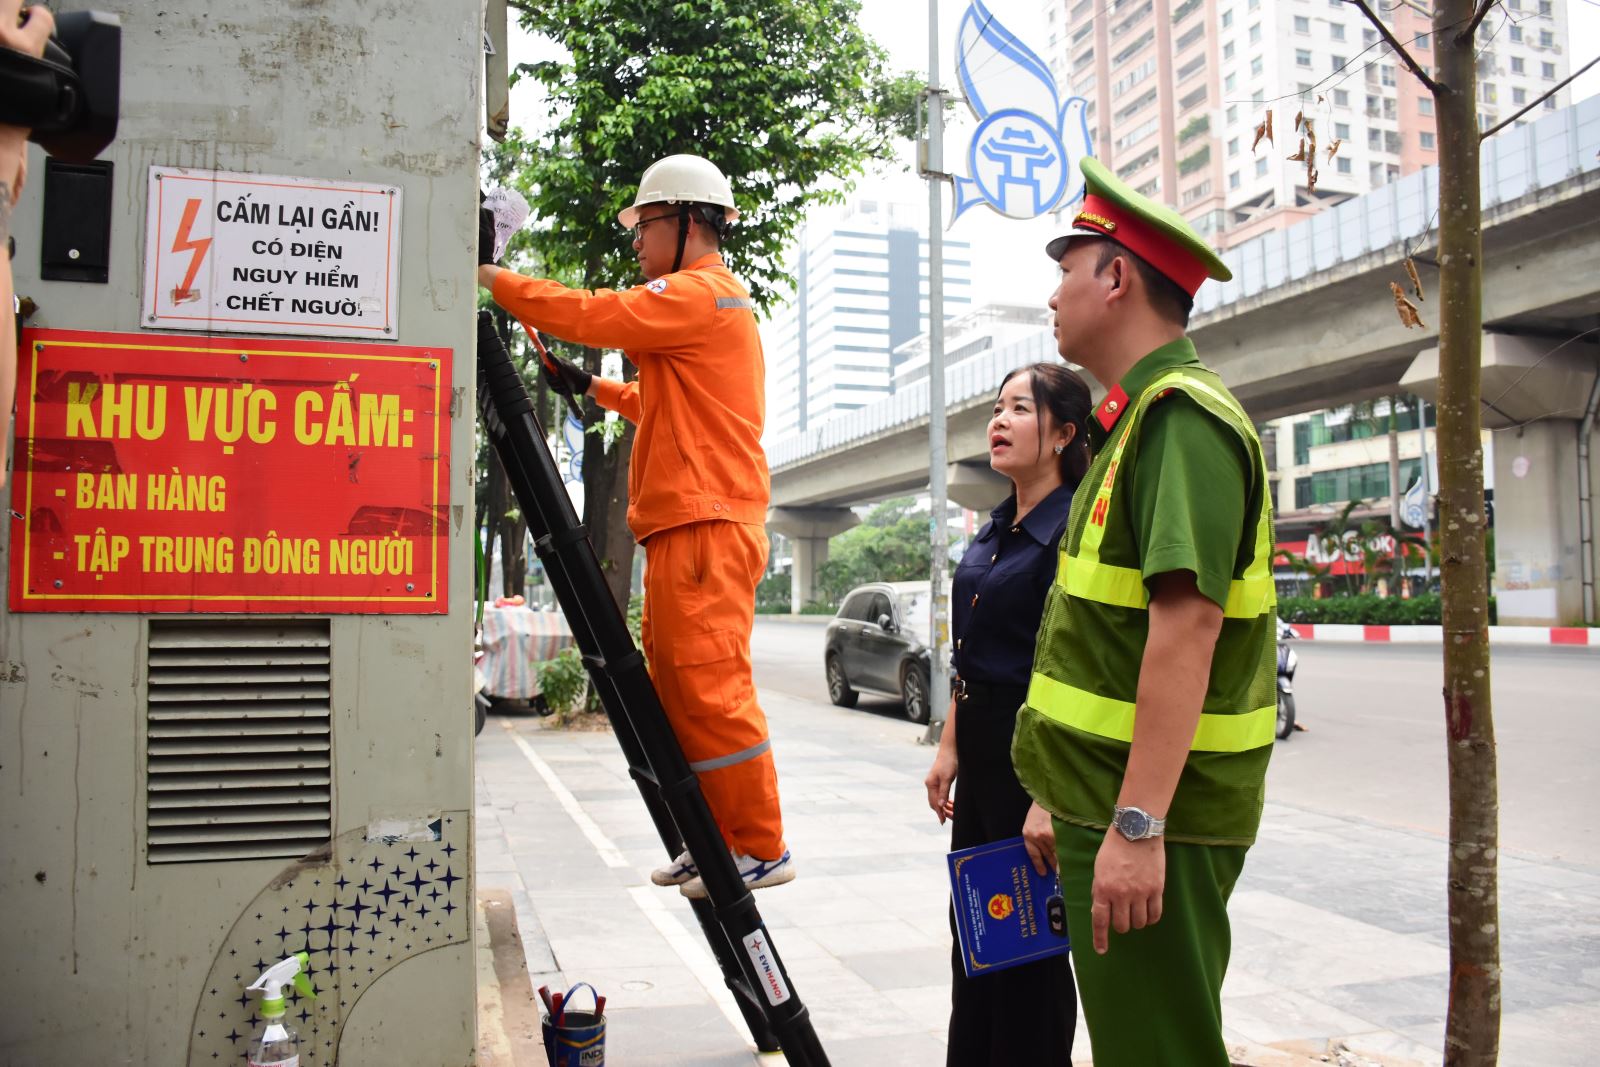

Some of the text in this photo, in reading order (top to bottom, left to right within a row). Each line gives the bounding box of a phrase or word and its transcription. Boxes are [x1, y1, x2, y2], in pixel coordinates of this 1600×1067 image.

[216, 193, 379, 234] CẤM LẠI GẦN!
[251, 238, 343, 262] CÓ ĐIỆN
[232, 265, 359, 288] NGUY HIỂM
[226, 292, 284, 312] CHẾT
[66, 373, 414, 455] KHU VỰC CẤM:
[76, 465, 137, 510] BÁN
[147, 467, 226, 512] HÀNG
[74, 527, 130, 580] TẬP
[139, 535, 234, 574] TRUNG
[243, 530, 320, 575] ĐÔNG
[329, 530, 413, 576] NGƯỜI
